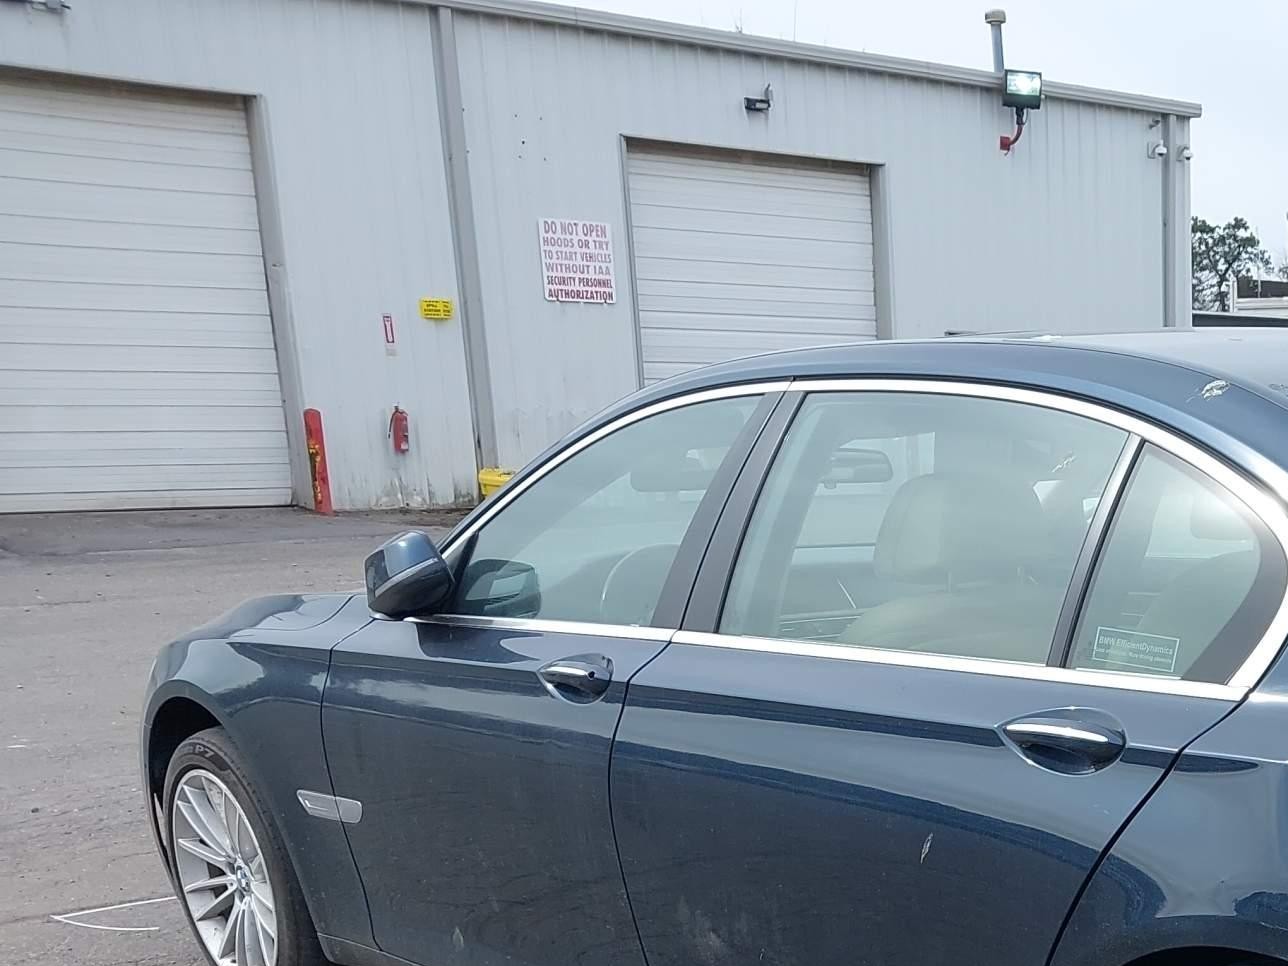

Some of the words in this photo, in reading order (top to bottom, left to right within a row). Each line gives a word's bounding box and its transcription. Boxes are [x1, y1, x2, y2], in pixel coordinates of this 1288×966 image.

[543, 221, 557, 234] DO
[560, 222, 579, 236] NOT
[582, 223, 607, 239] OPEN
[543, 236, 575, 248] HOODS
[577, 239, 590, 249] OR
[593, 240, 610, 251] TRY
[543, 250, 553, 260] TO
[555, 250, 578, 262] START
[580, 252, 612, 263] VEHICLES
[545, 262, 591, 275] WITHOUT
[593, 265, 611, 276] IAA
[546, 275, 577, 287] SECURITY
[578, 277, 613, 289] PERSONNEL
[548, 288, 614, 301] AUTHORIZATION
